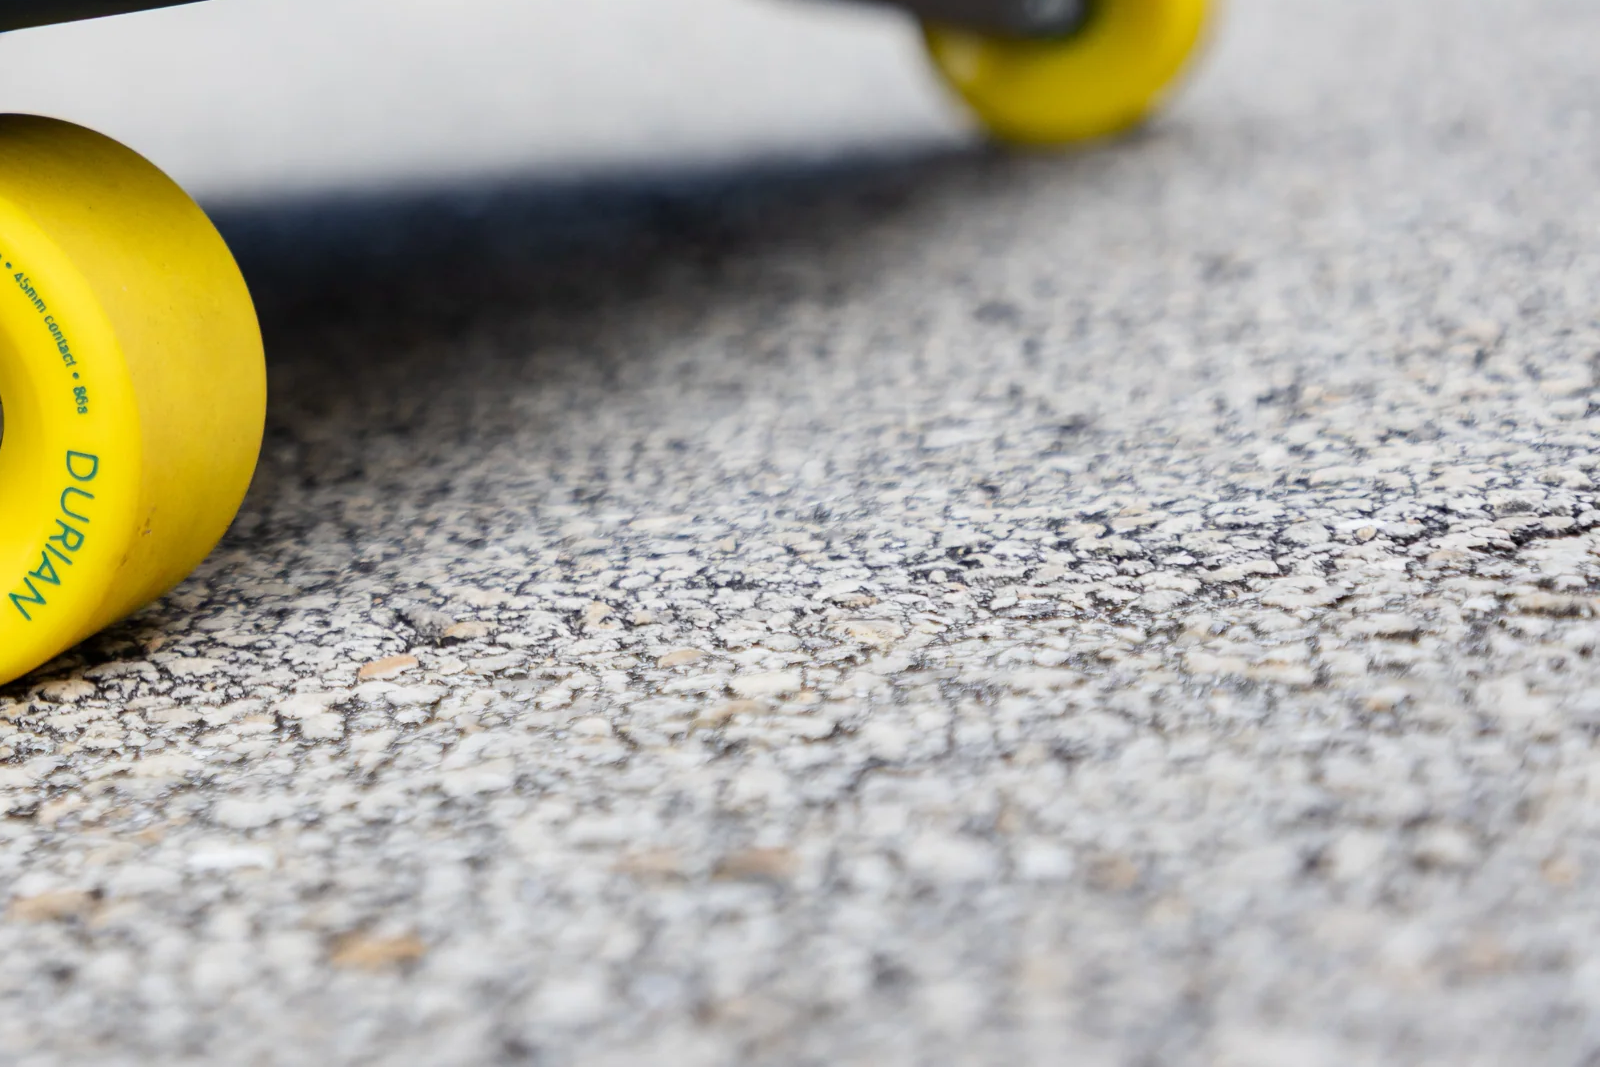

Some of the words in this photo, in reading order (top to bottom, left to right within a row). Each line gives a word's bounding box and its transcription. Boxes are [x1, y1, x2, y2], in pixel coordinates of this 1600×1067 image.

[13, 272, 46, 313] 45mm
[44, 315, 77, 367] contact
[8, 450, 99, 621] DURIAN
